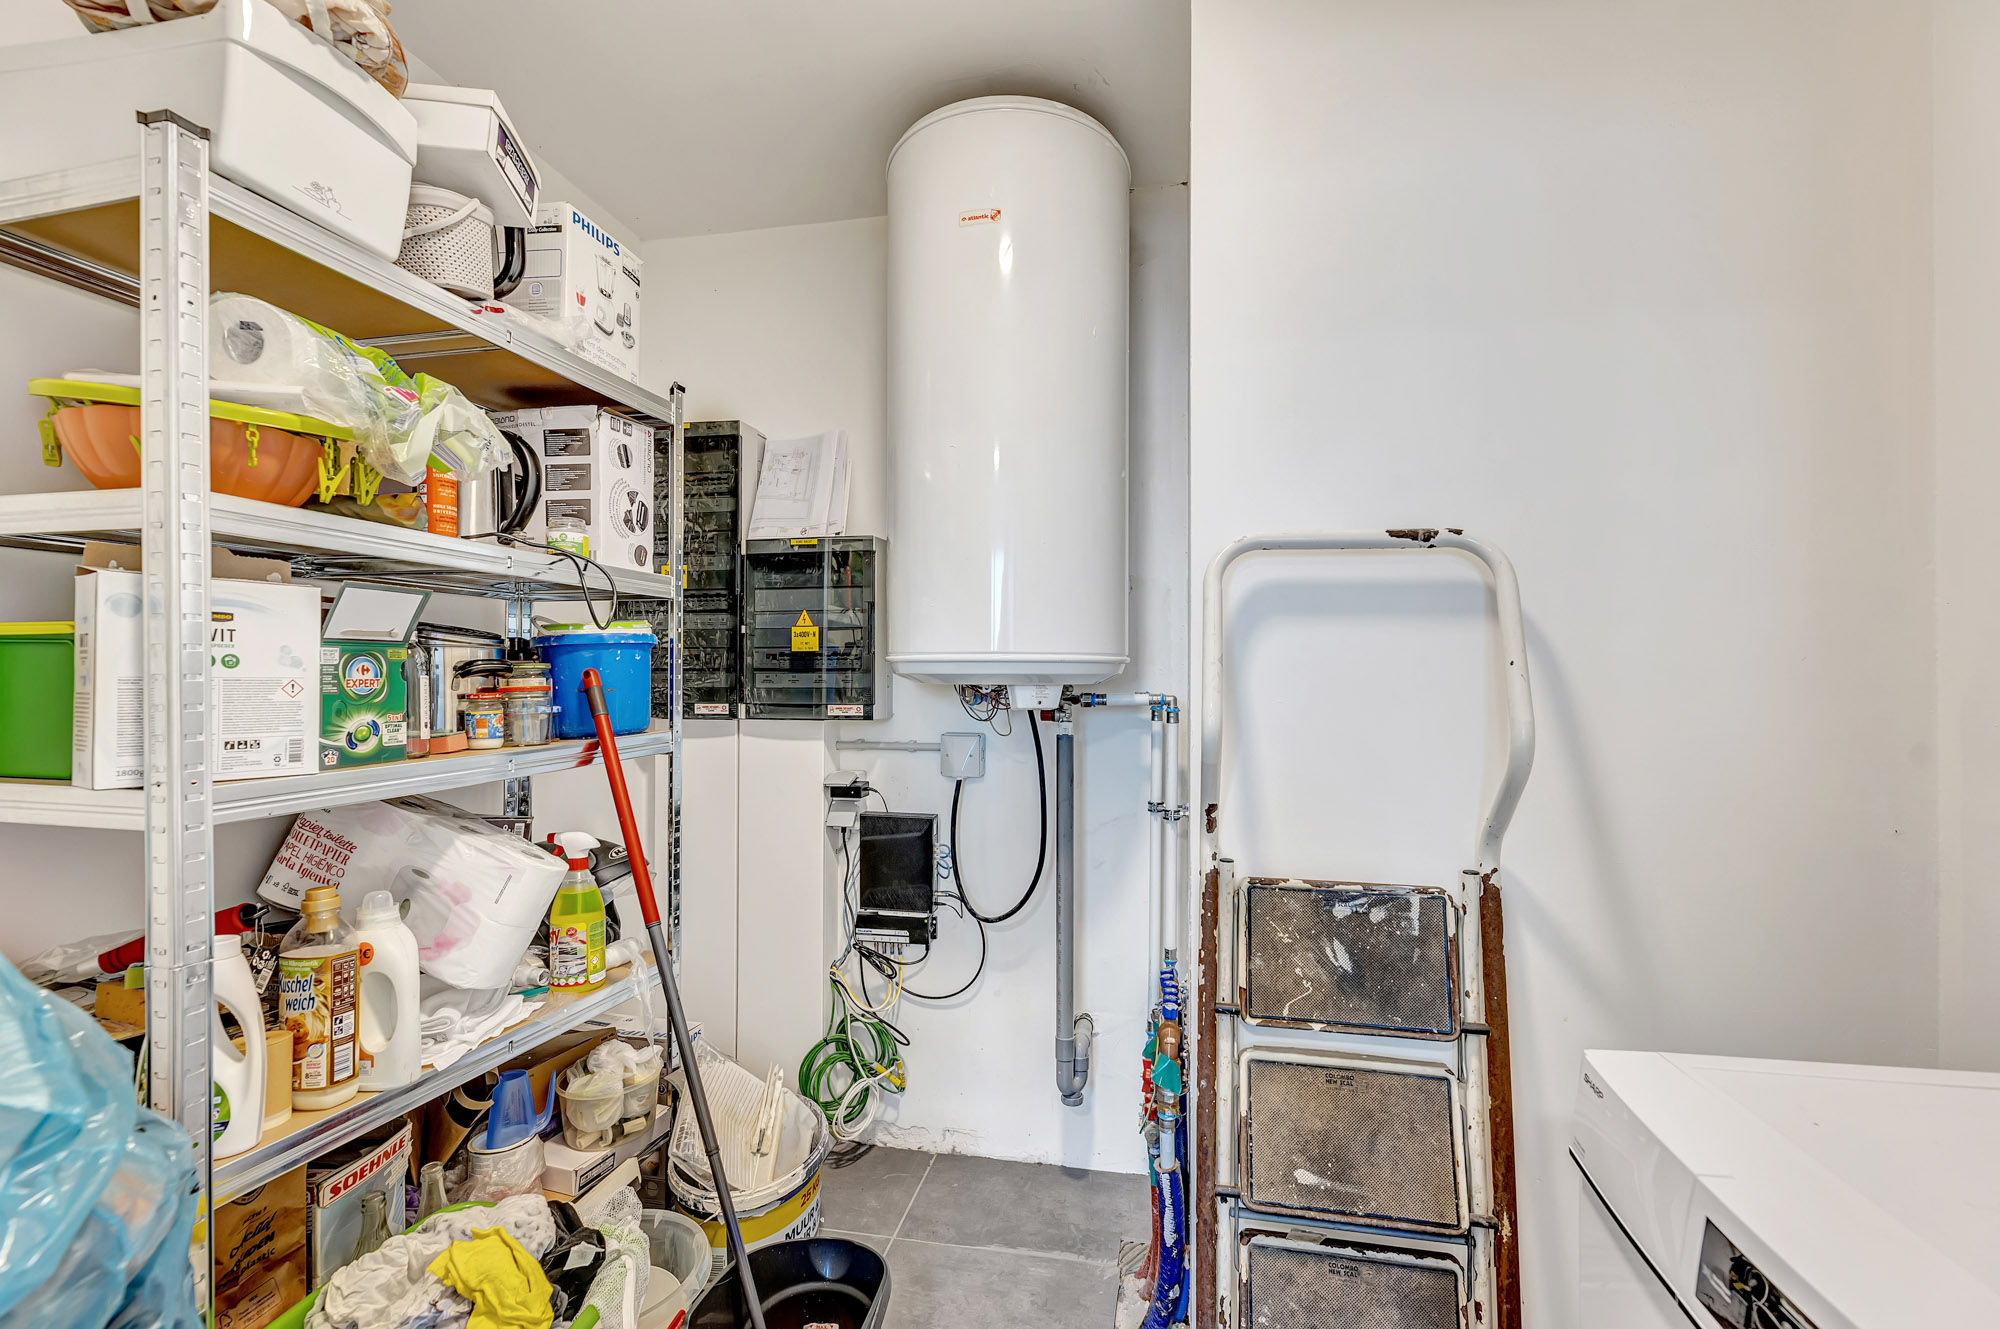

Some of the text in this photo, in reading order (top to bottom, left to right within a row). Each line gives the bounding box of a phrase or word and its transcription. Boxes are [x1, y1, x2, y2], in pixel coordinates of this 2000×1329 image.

[573, 211, 620, 256] PHILIPS
[345, 678, 381, 689] EXPERT
[323, 829, 358, 854] toilette
[285, 841, 345, 879] APEL HIGIÉNICO
[276, 854, 341, 890] arta Igienica
[280, 973, 313, 993] Kuschel
[286, 993, 315, 1011] weich
[1325, 1073, 1355, 1081] COLOMBO
[329, 1134, 407, 1201] SOEHNLE
[801, 1187, 812, 1208] 25
[241, 1248, 276, 1276] plastic
[1328, 1262, 1359, 1271] COLOMBO
[1343, 1270, 1358, 1278] SCAL
